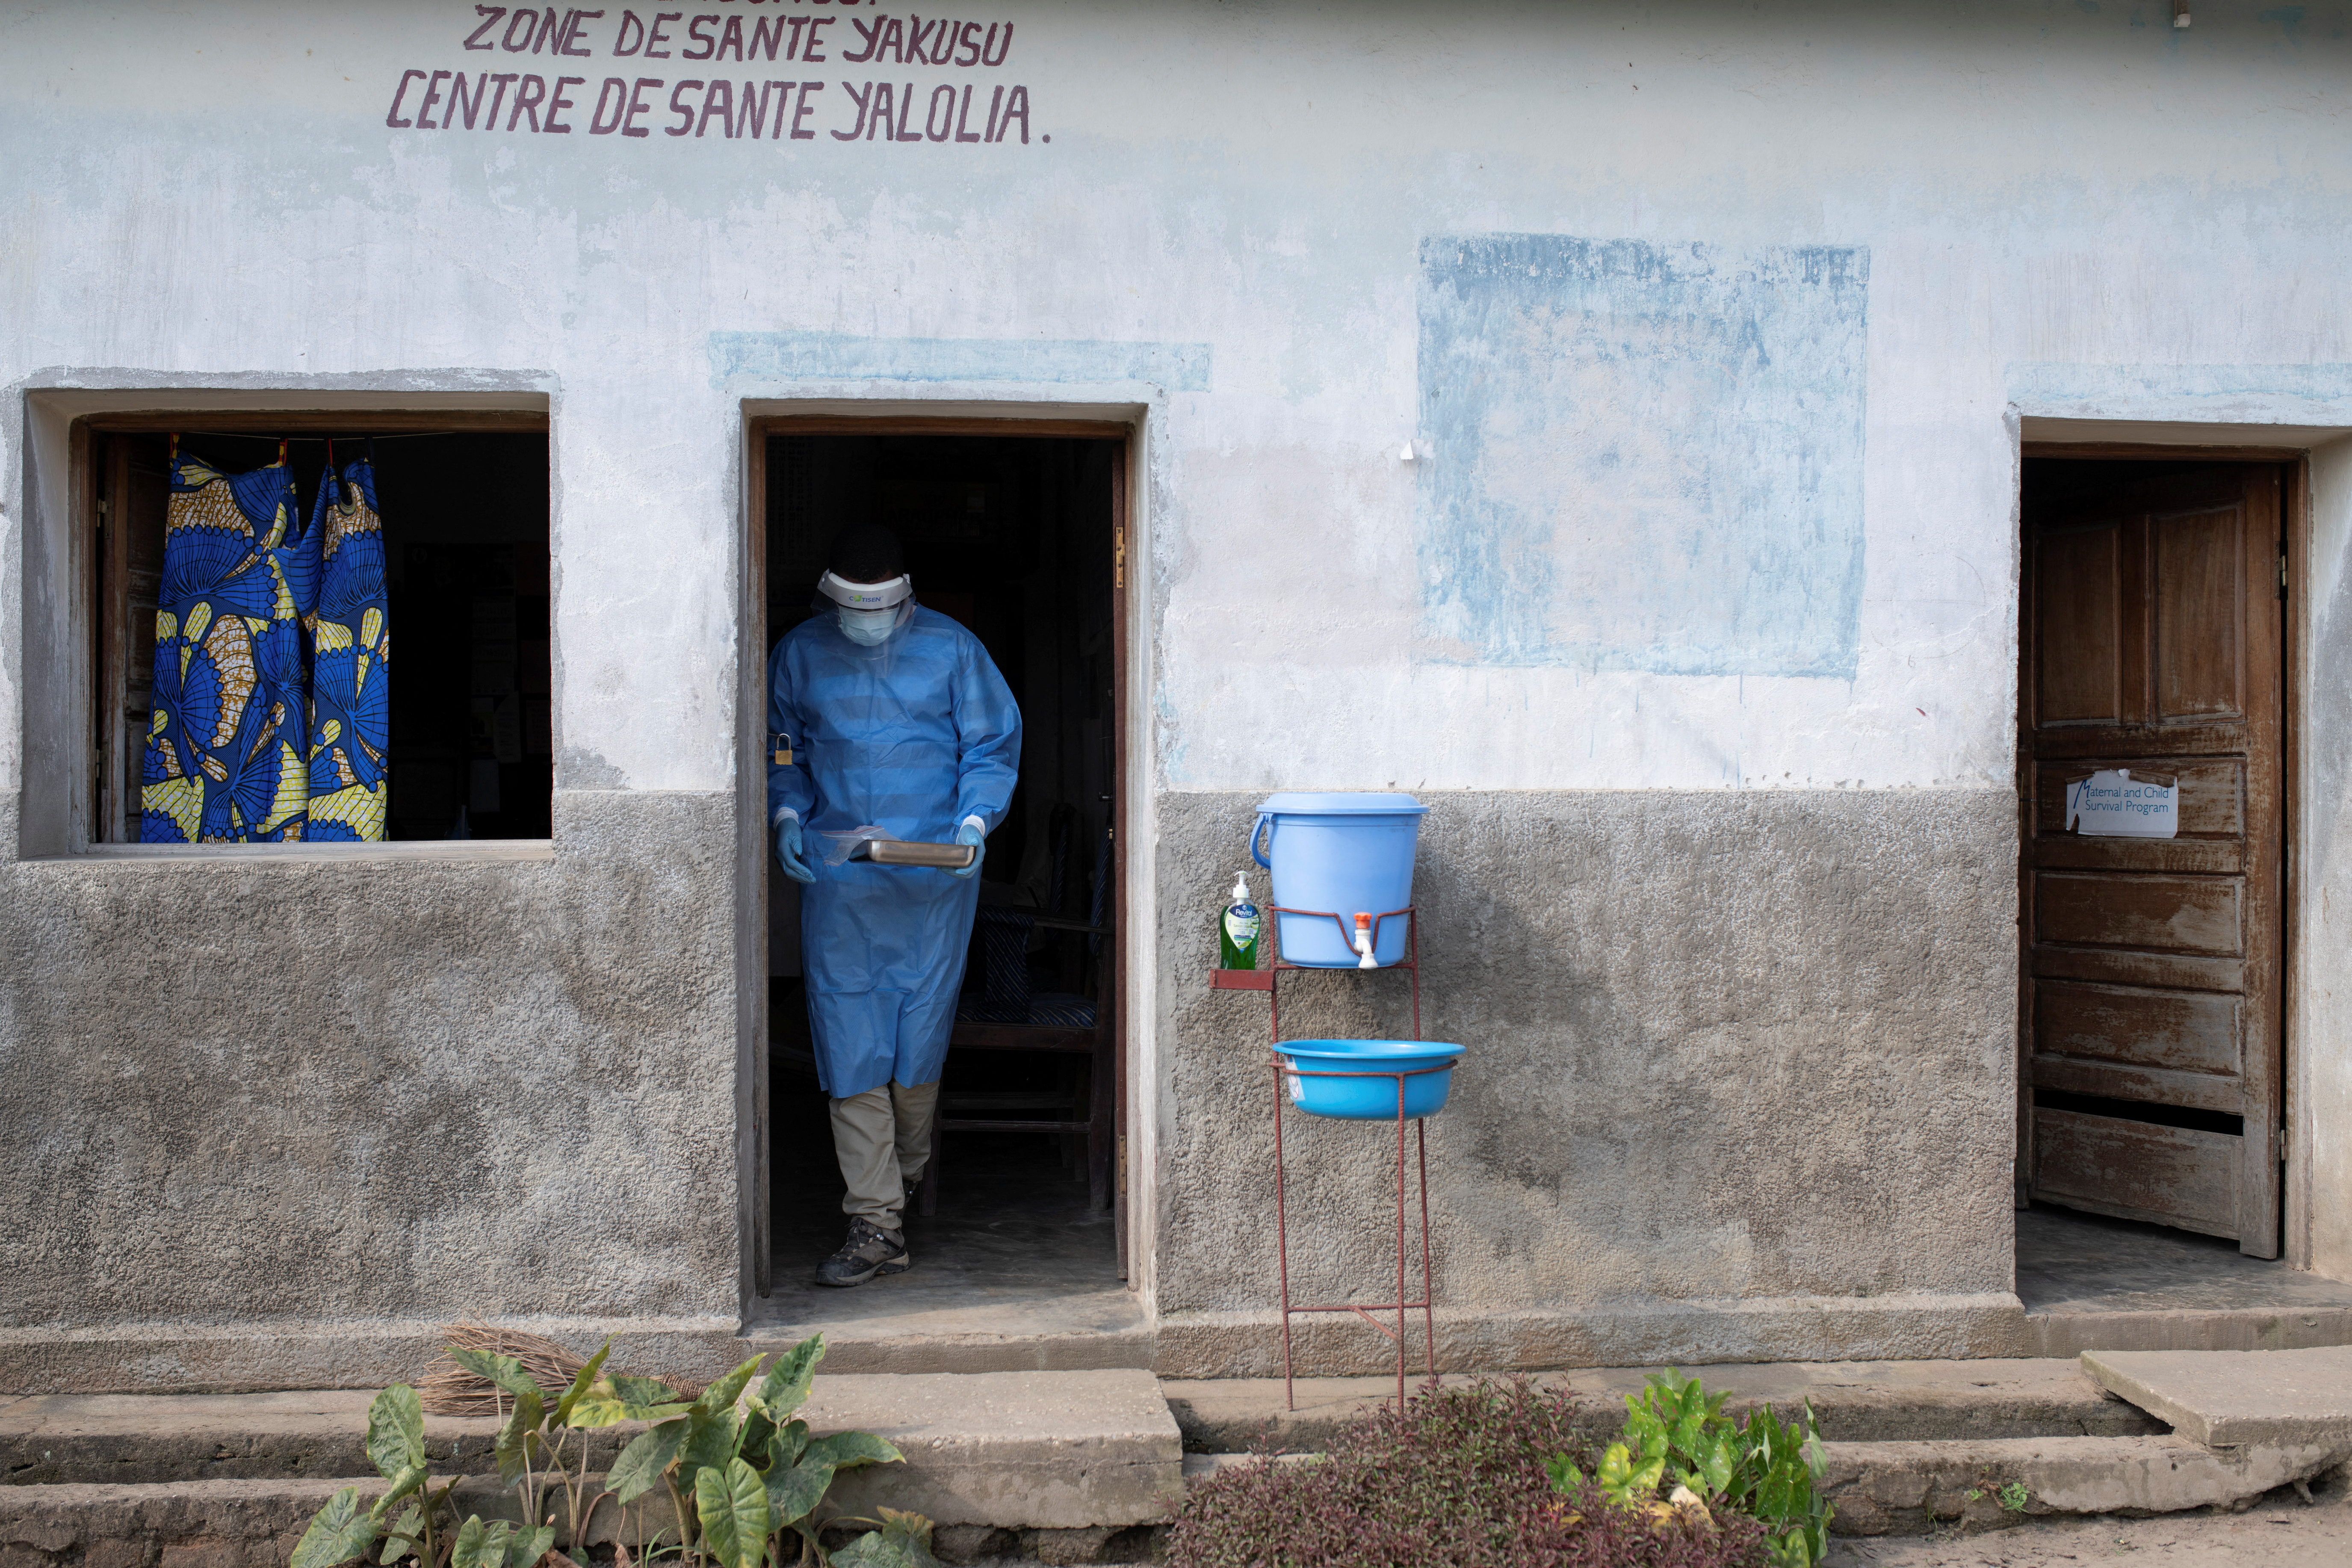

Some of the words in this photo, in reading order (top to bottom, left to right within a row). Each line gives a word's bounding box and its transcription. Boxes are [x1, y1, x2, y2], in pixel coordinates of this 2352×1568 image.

[464, 5, 605, 56] ZONE
[613, 9, 683, 59] DE
[683, 15, 836, 62] SANTE
[842, 15, 1014, 67] YAKUSU
[386, 70, 585, 133] CENTRE
[591, 77, 664, 139] DE
[665, 80, 824, 140] SANTE
[2073, 779, 2121, 809] Maternal
[2124, 787, 2141, 797] and
[2144, 787, 2169, 798] Child
[2086, 800, 2122, 811] Survival
[2126, 801, 2168, 815] Program
